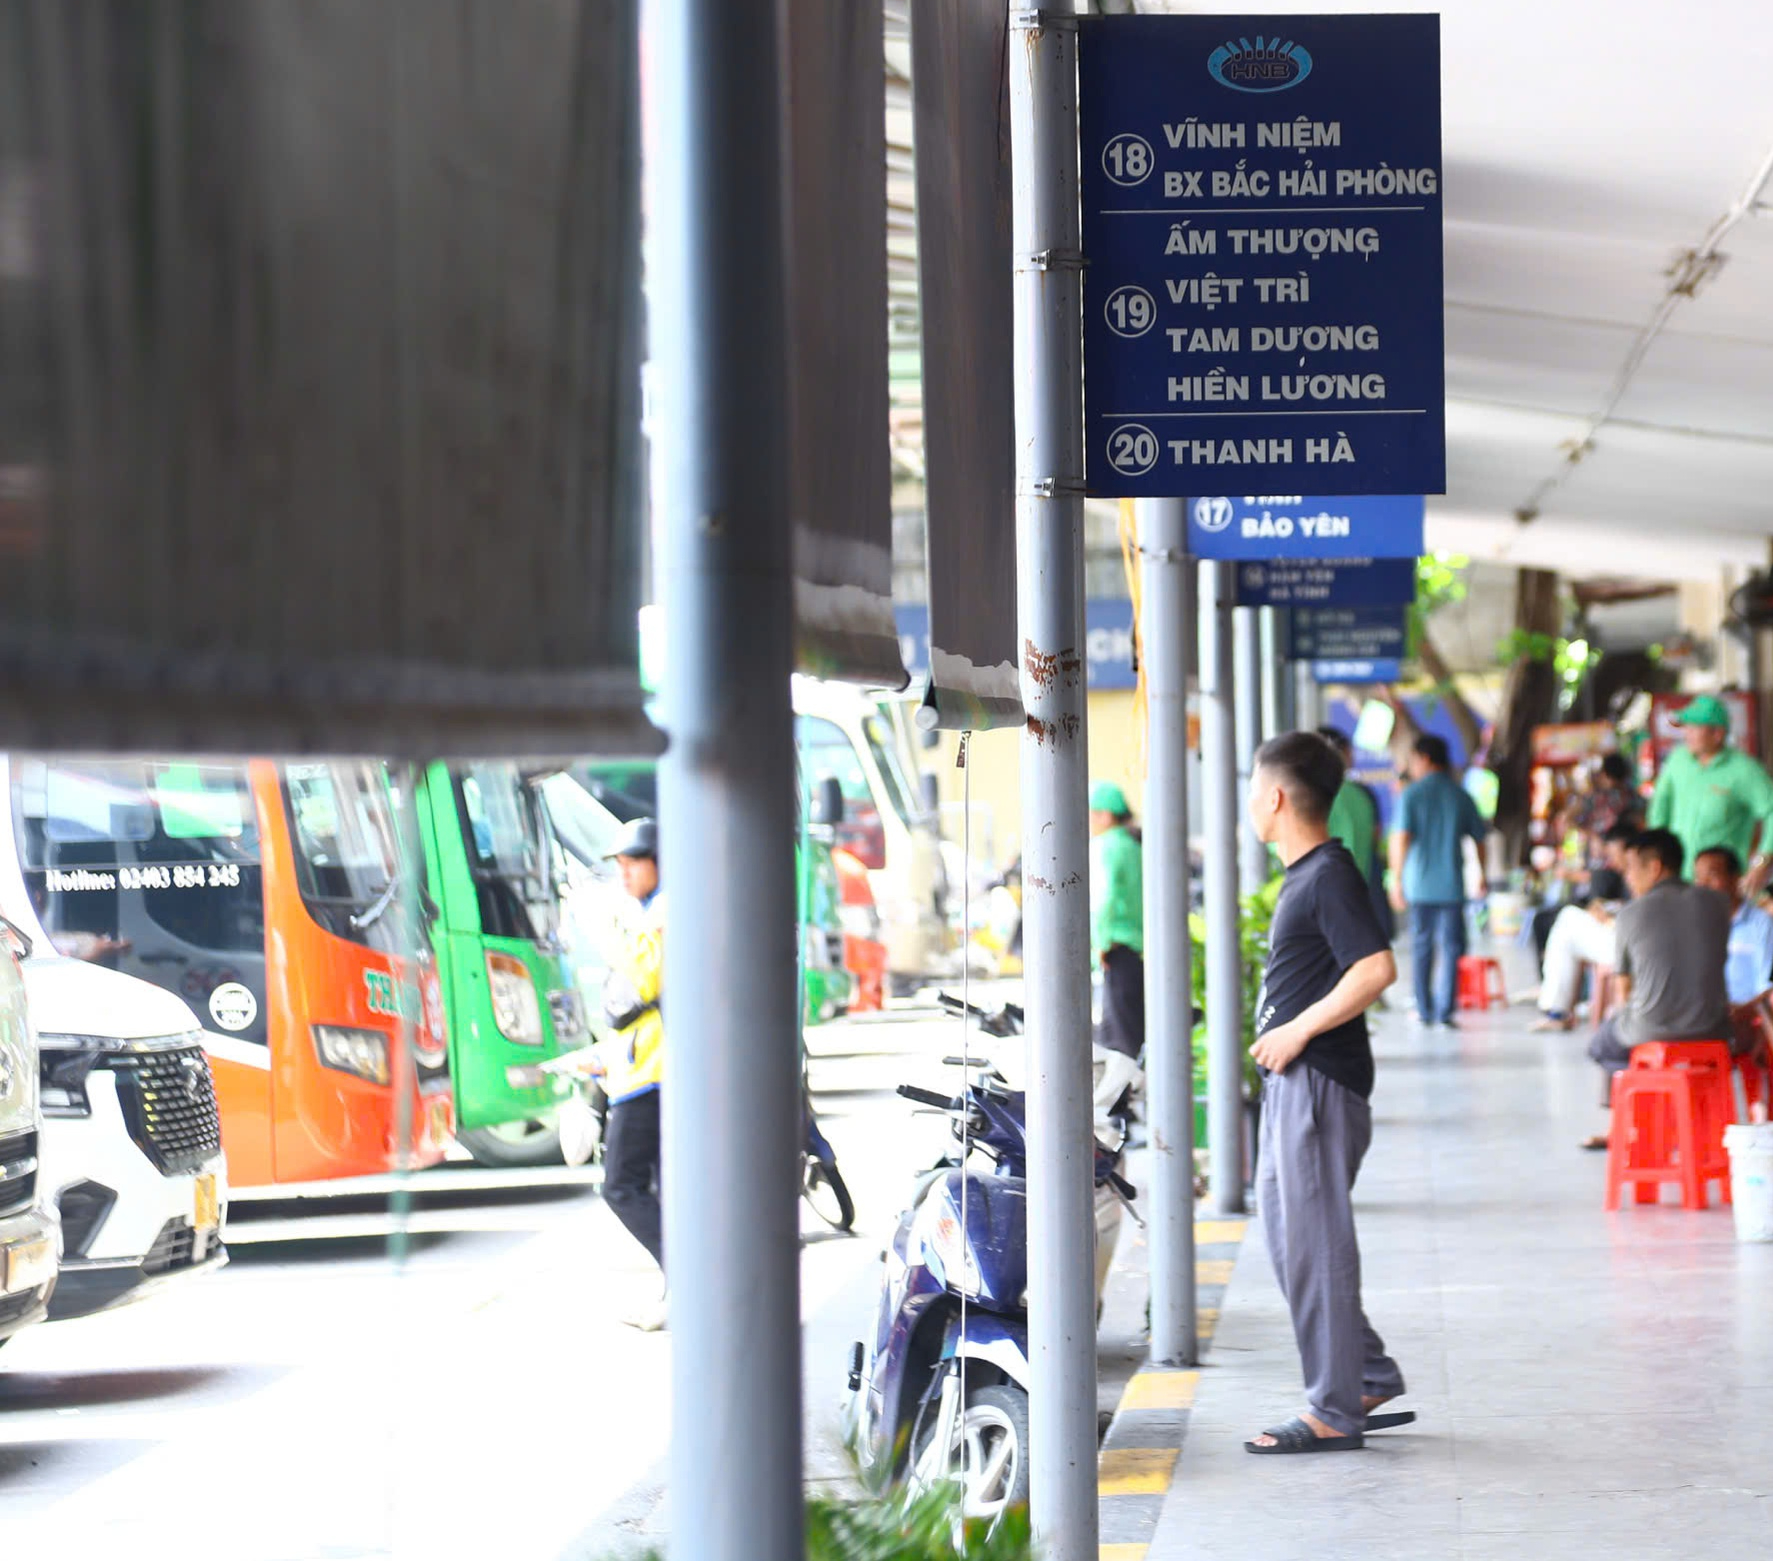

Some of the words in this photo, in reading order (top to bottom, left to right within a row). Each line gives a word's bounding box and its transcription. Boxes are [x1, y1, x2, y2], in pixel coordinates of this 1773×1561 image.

[1232, 63, 1289, 80] HNB
[1163, 117, 1246, 148] VĨNH
[1257, 116, 1341, 154] NIỆM
[1109, 143, 1147, 177] 18
[1164, 171, 1204, 197] BX
[1212, 158, 1270, 197] BẮC
[1279, 160, 1327, 196] HẢI
[1336, 162, 1437, 195] PHÒNG
[1164, 220, 1217, 255] ẤM
[1227, 228, 1380, 260] THƯỢNG
[1165, 272, 1243, 310] VIỆT
[1254, 271, 1309, 303] TRÌ
[1111, 294, 1150, 329] 19
[1166, 327, 1240, 352] TAM
[1251, 325, 1379, 351] DƯƠNG
[1168, 366, 1249, 401] HIỀN
[1262, 374, 1385, 400] LƯƠNG
[1114, 432, 1154, 466] 20
[1168, 439, 1293, 464] THANH
[1305, 431, 1355, 463] HÀ
[1199, 500, 1227, 525] 17
[1241, 511, 1294, 538] BẢO
[1299, 512, 1350, 538] YÊN
[46, 868, 115, 891] Hotline:
